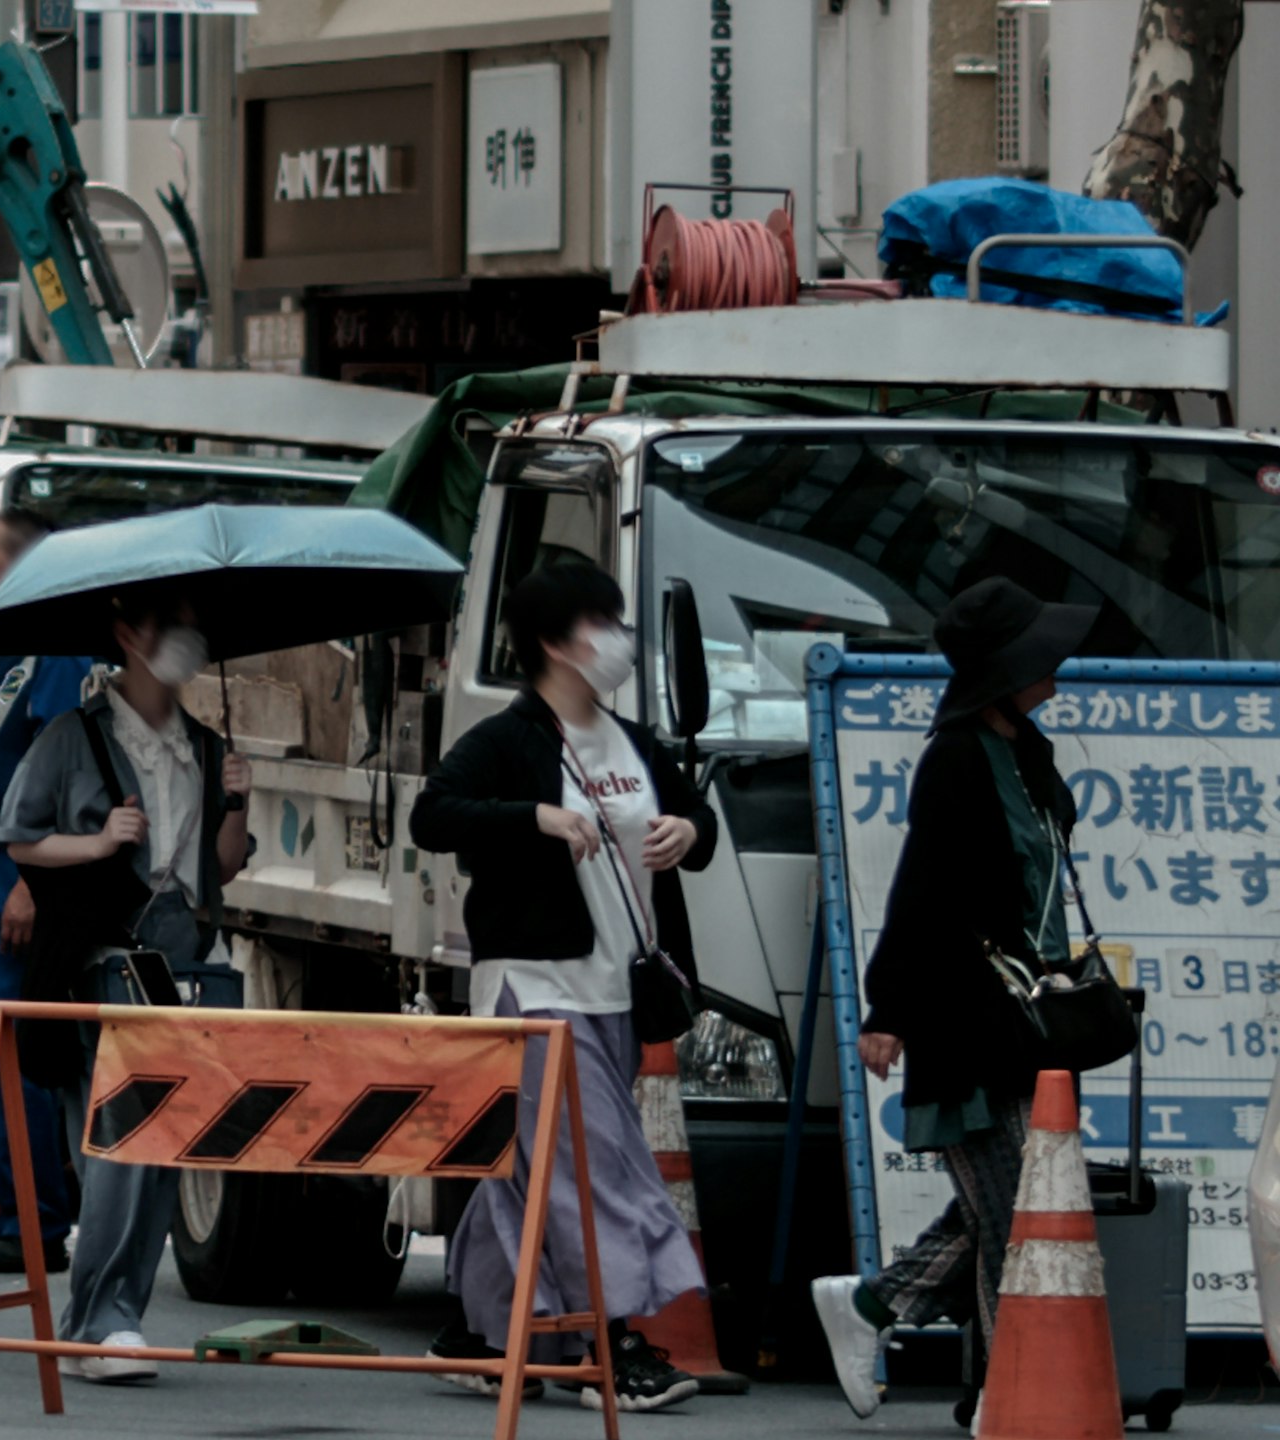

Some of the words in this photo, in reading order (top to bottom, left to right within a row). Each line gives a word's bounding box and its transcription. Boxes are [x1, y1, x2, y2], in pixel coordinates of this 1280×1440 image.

[711, 46, 733, 147] FRENCH
[274, 144, 389, 202] ANZEN
[485, 127, 537, 189] 明伸
[711, 153, 733, 220] CLUB
